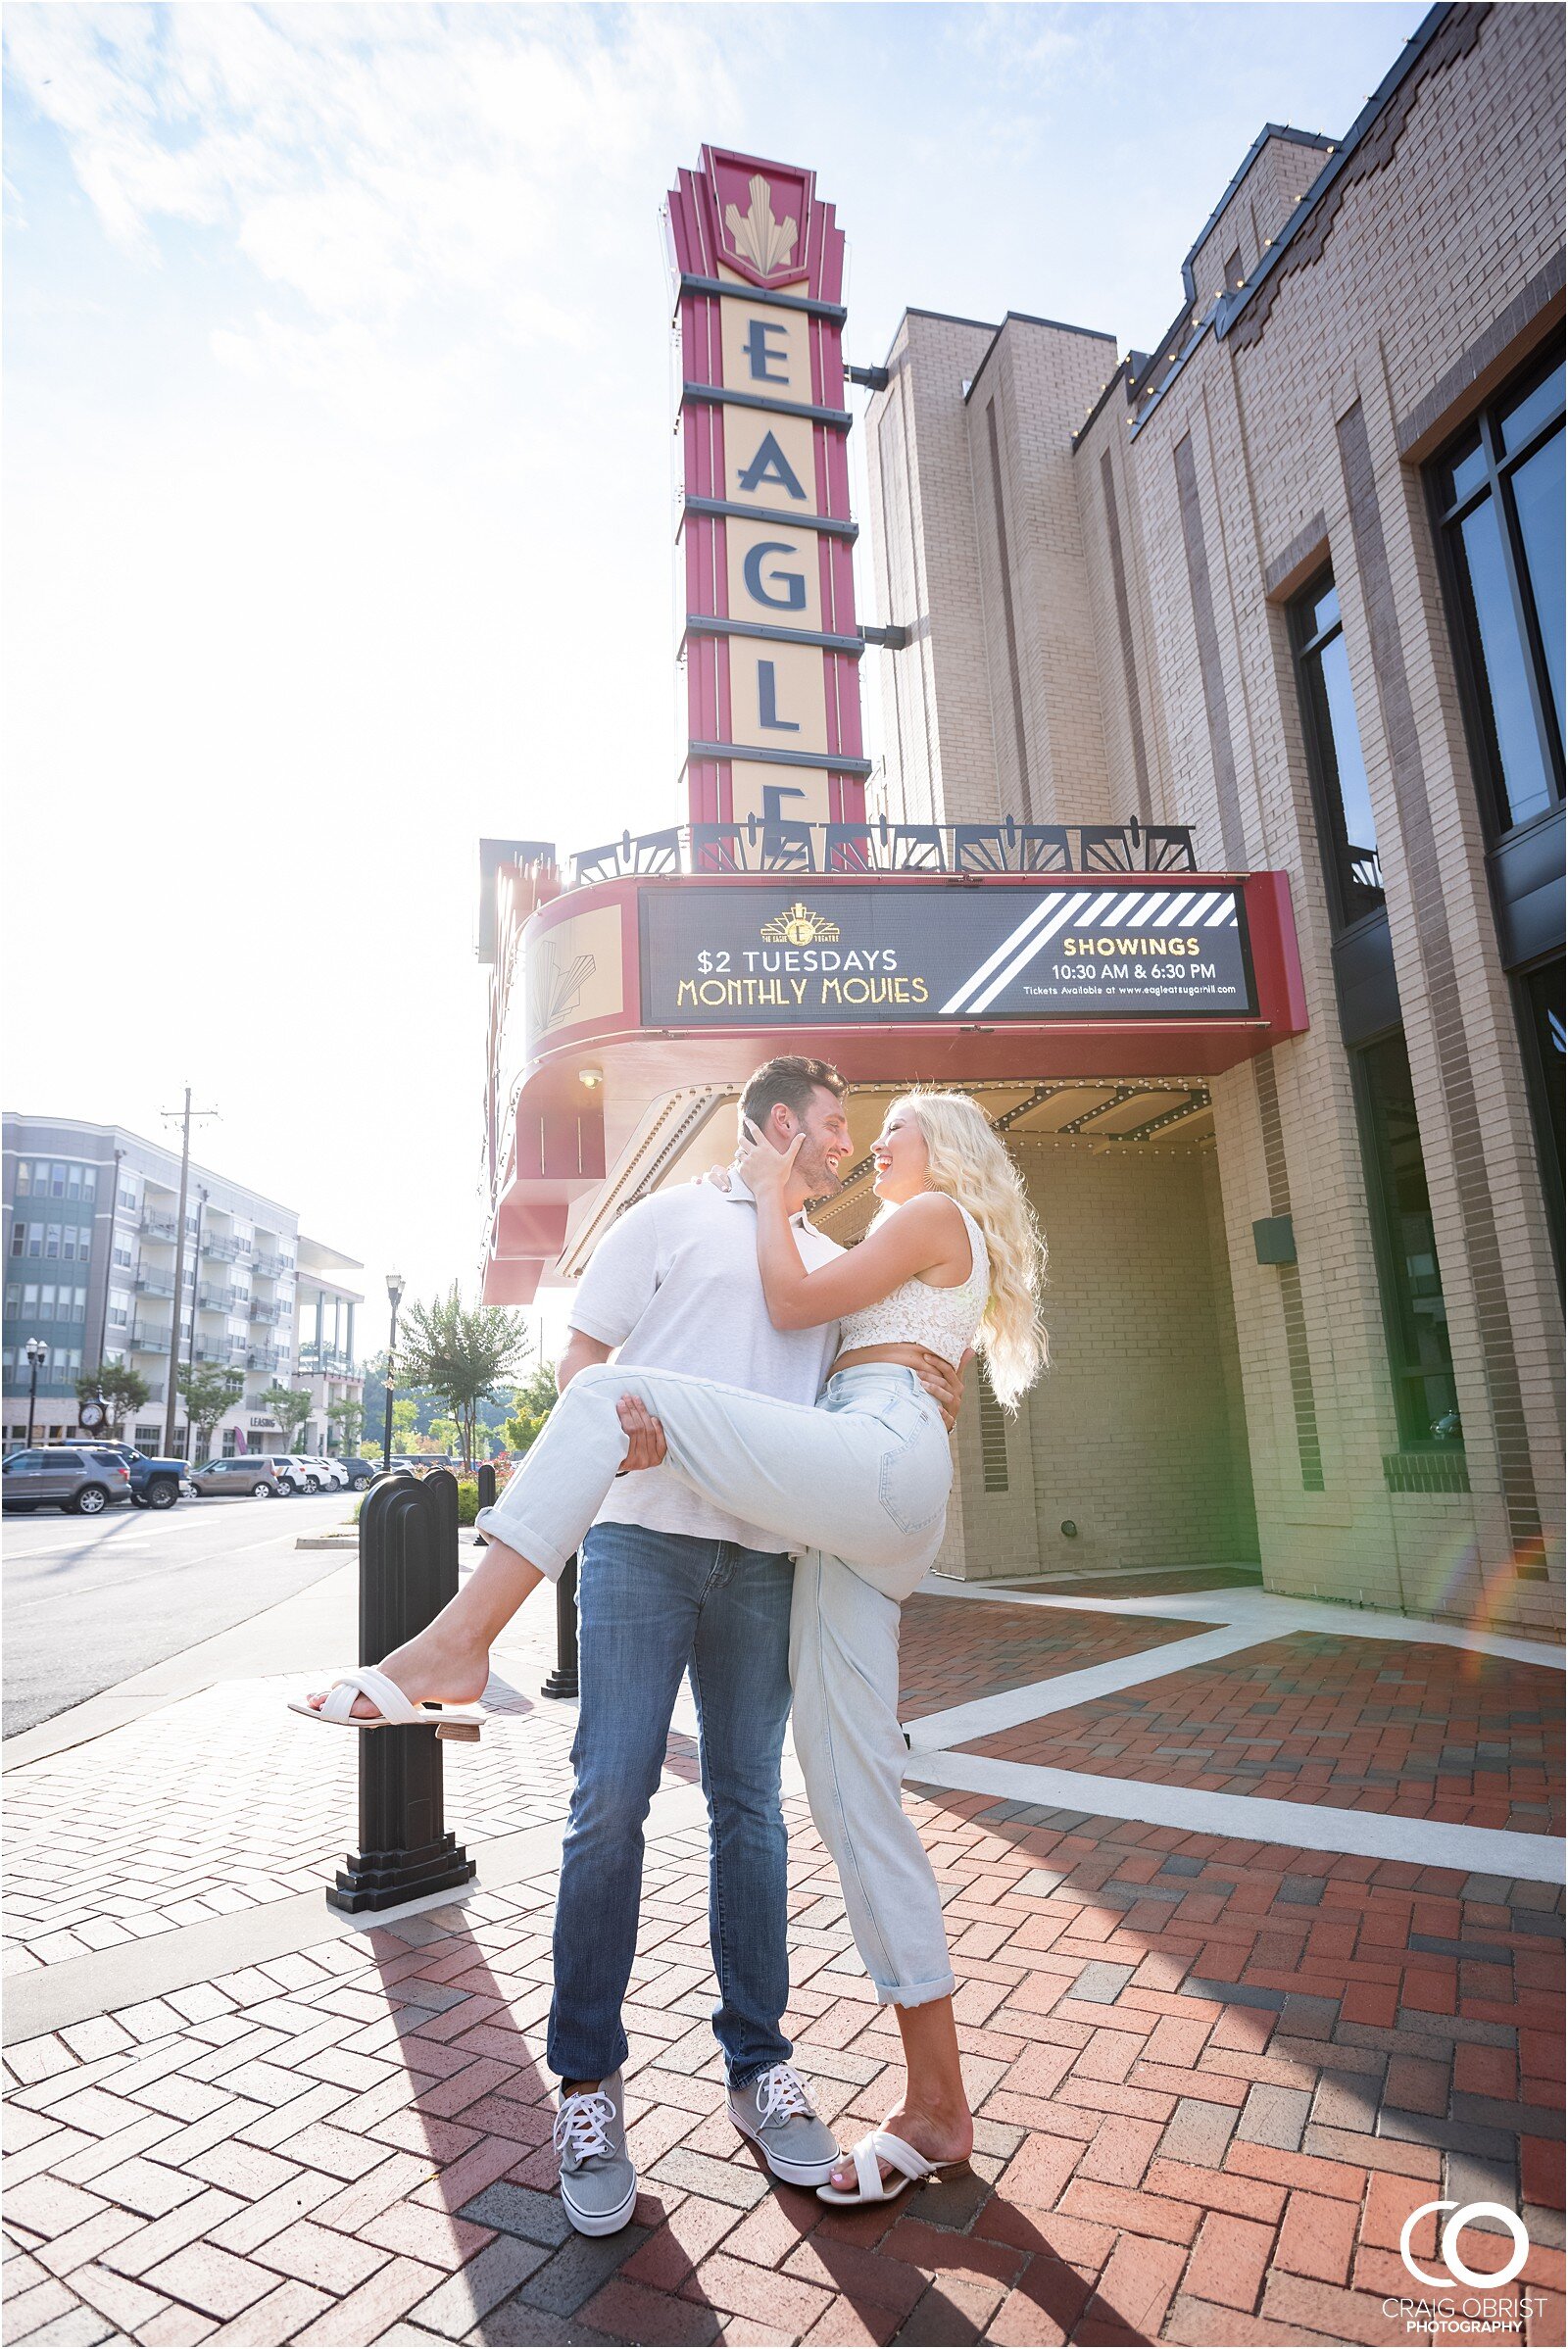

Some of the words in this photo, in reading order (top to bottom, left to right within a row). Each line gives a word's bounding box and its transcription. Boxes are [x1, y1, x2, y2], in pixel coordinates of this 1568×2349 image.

[739, 318, 808, 858] EAGLE
[1063, 937, 1200, 956] SHOWINGS
[697, 950, 731, 974] $2
[743, 950, 898, 972] TUESDAYS
[1052, 964, 1097, 980] 10:30
[1101, 964, 1128, 979] AM
[1134, 964, 1148, 979] &
[1151, 963, 1186, 979] 6:30
[1191, 963, 1216, 979] PM
[677, 979, 808, 1005] MONTHLY
[821, 977, 929, 1004] MOVIES
[1023, 986, 1058, 996] Tickets
[1061, 986, 1102, 995] Available
[1105, 986, 1116, 995] at
[250, 1417, 276, 1428] LEASING
